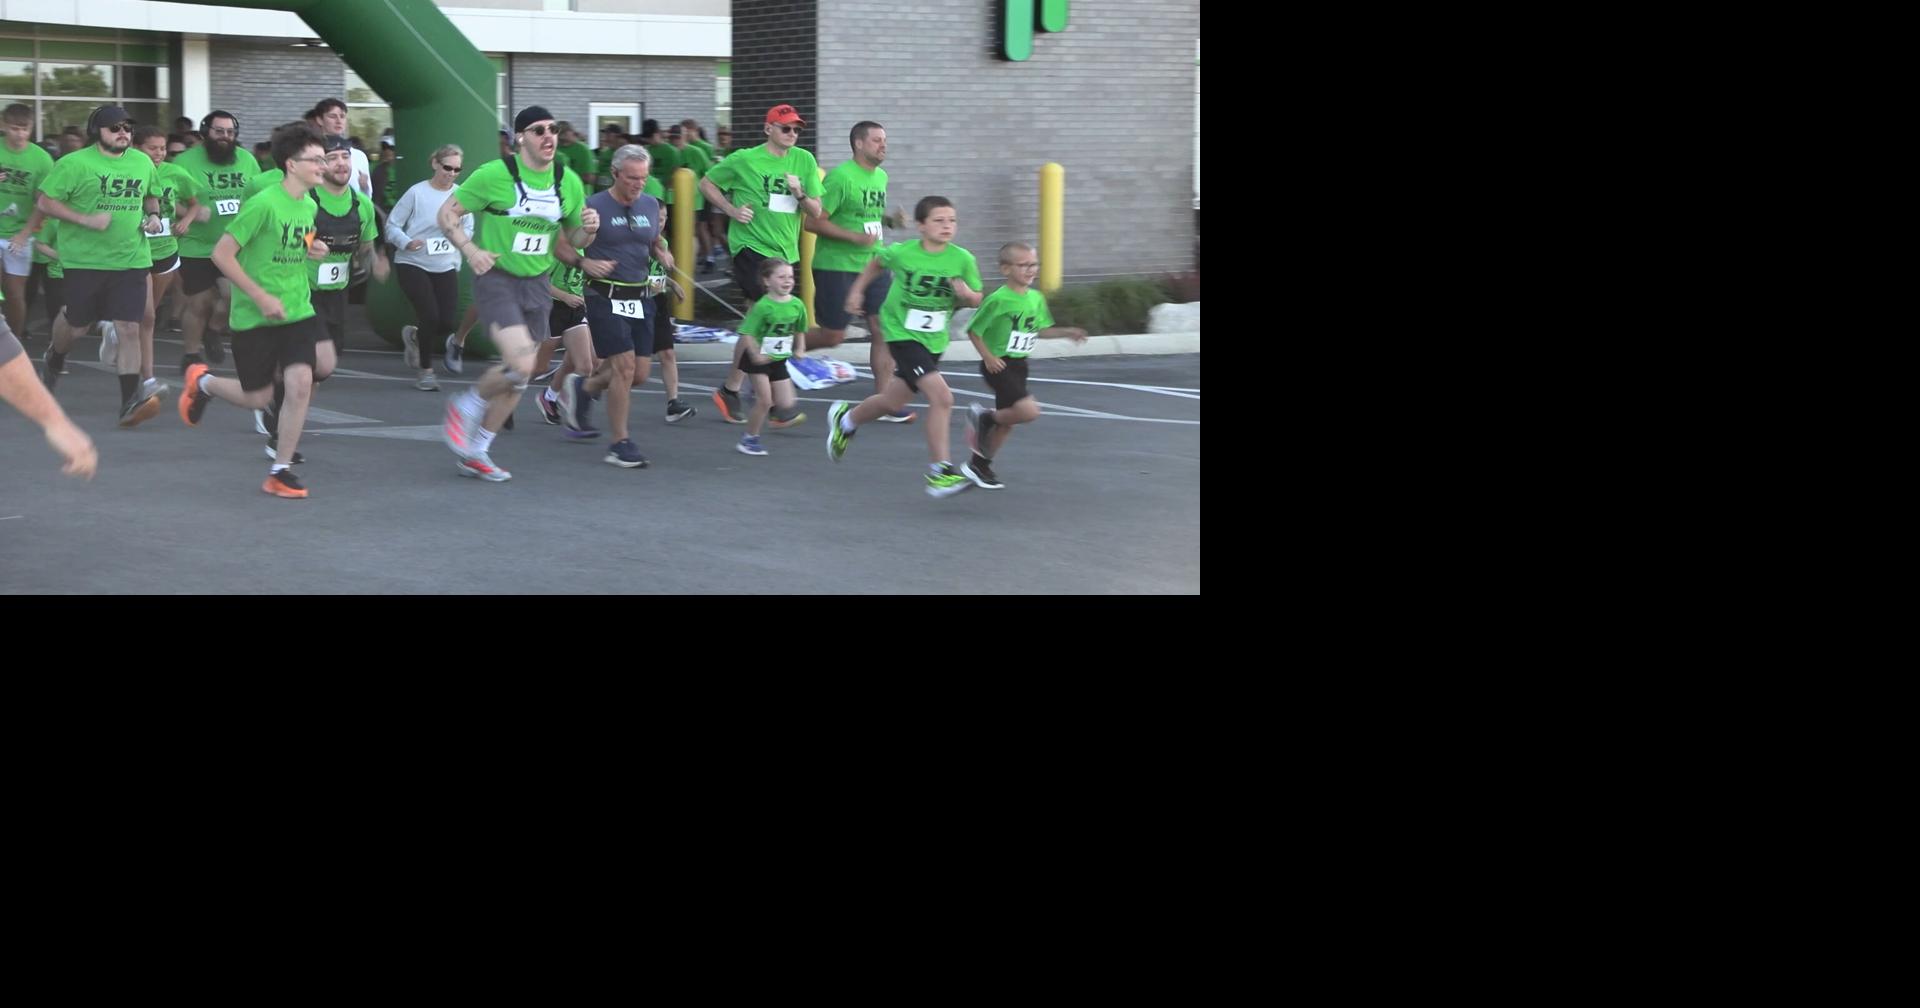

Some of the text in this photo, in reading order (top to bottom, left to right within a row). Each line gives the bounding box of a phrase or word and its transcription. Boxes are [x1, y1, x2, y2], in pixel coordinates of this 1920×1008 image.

[218, 172, 244, 189] 5K
[111, 179, 142, 198] 5K
[433, 239, 450, 252] 26
[521, 236, 543, 253] 11
[330, 266, 340, 281] 9
[920, 315, 933, 329] 2
[773, 340, 784, 352] 4
